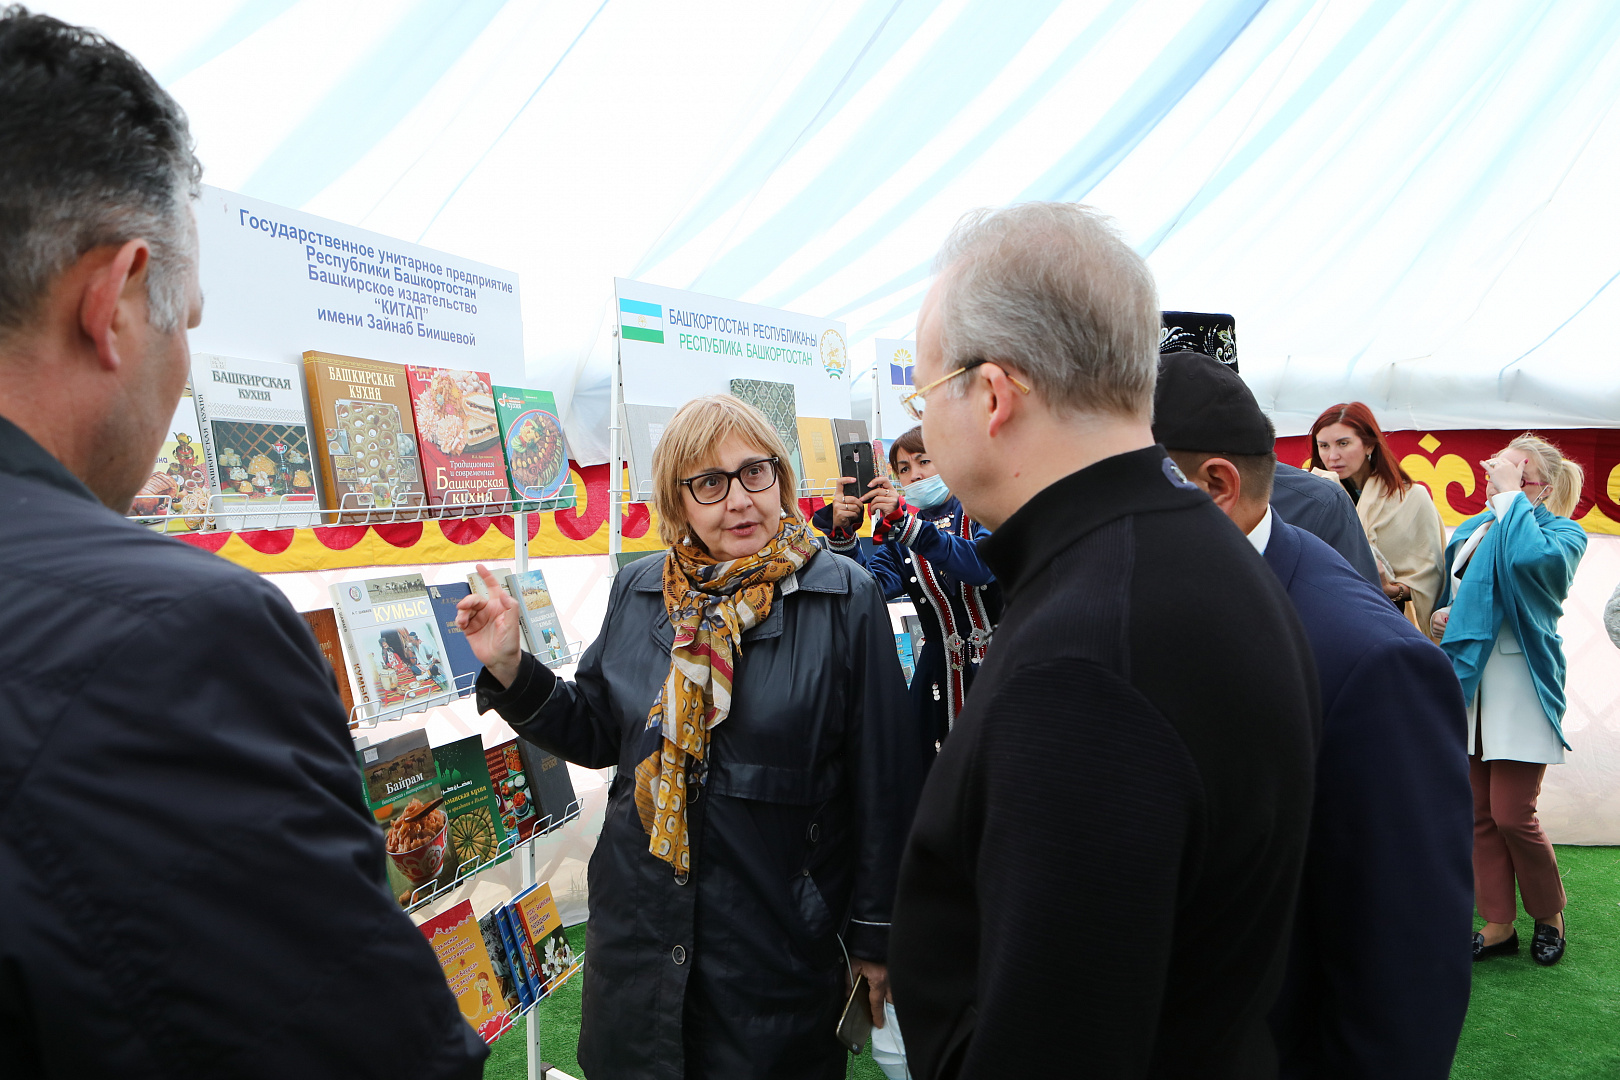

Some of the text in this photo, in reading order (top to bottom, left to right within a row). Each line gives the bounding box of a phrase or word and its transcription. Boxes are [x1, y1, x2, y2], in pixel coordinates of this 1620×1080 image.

[239, 208, 513, 294] Государственное унитарное предприятие
[306, 245, 477, 300] Республики Башкортостан
[308, 264, 478, 315] Башкирское издательство
[374, 297, 429, 321] “КИТАП”
[317, 307, 477, 346] имени Зайнаб Биишевой
[753, 322, 818, 348] РЕСПУБЛИКАҺЫ
[679, 333, 813, 366] РЕСПУБЛИКА БАШКОРТОСТАН
[212, 370, 293, 390] БАШКИРСКАЯ
[327, 366, 396, 388] БАШКИРСКАЯ
[238, 388, 272, 401] КУХНЯ
[348, 385, 382, 401] КУХНЯ
[198, 394, 217, 488] БАШКИРСКАЯ КУХНЯ
[450, 460, 495, 469] Традиционная
[456, 470, 495, 478] современная
[436, 467, 504, 490] Башкирская
[373, 600, 428, 622] КУМЫС
[353, 663, 370, 703] КУМЫС
[385, 772, 424, 795] Байрам
